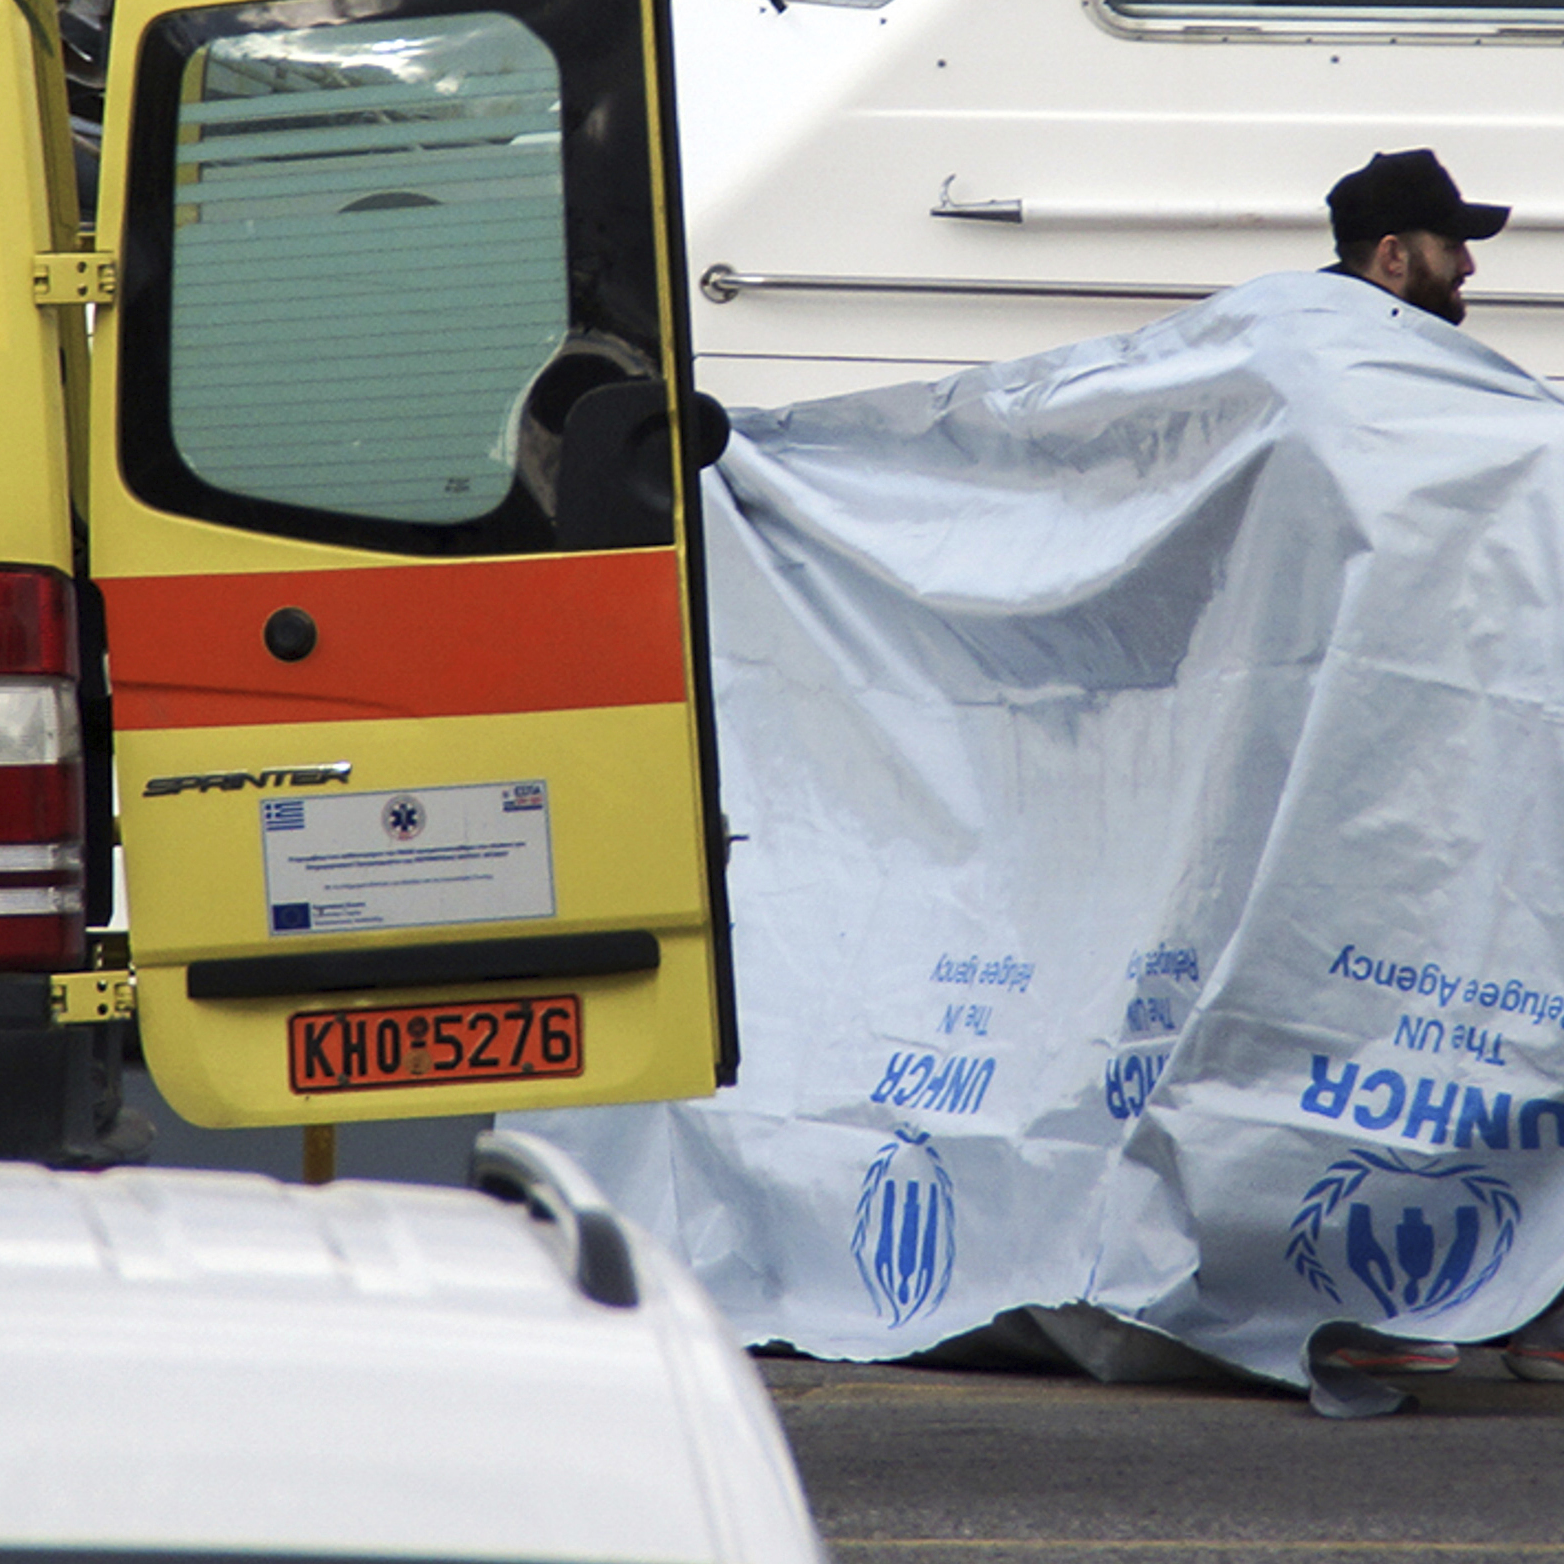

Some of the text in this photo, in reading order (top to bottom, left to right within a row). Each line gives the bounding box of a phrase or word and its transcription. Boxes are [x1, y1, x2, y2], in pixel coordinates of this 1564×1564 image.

[142, 760, 353, 798] SPRINTER
[1328, 943, 1462, 1008] Agency
[1393, 1013, 1507, 1067] The UN
[869, 1051, 997, 1116] UNHCR
